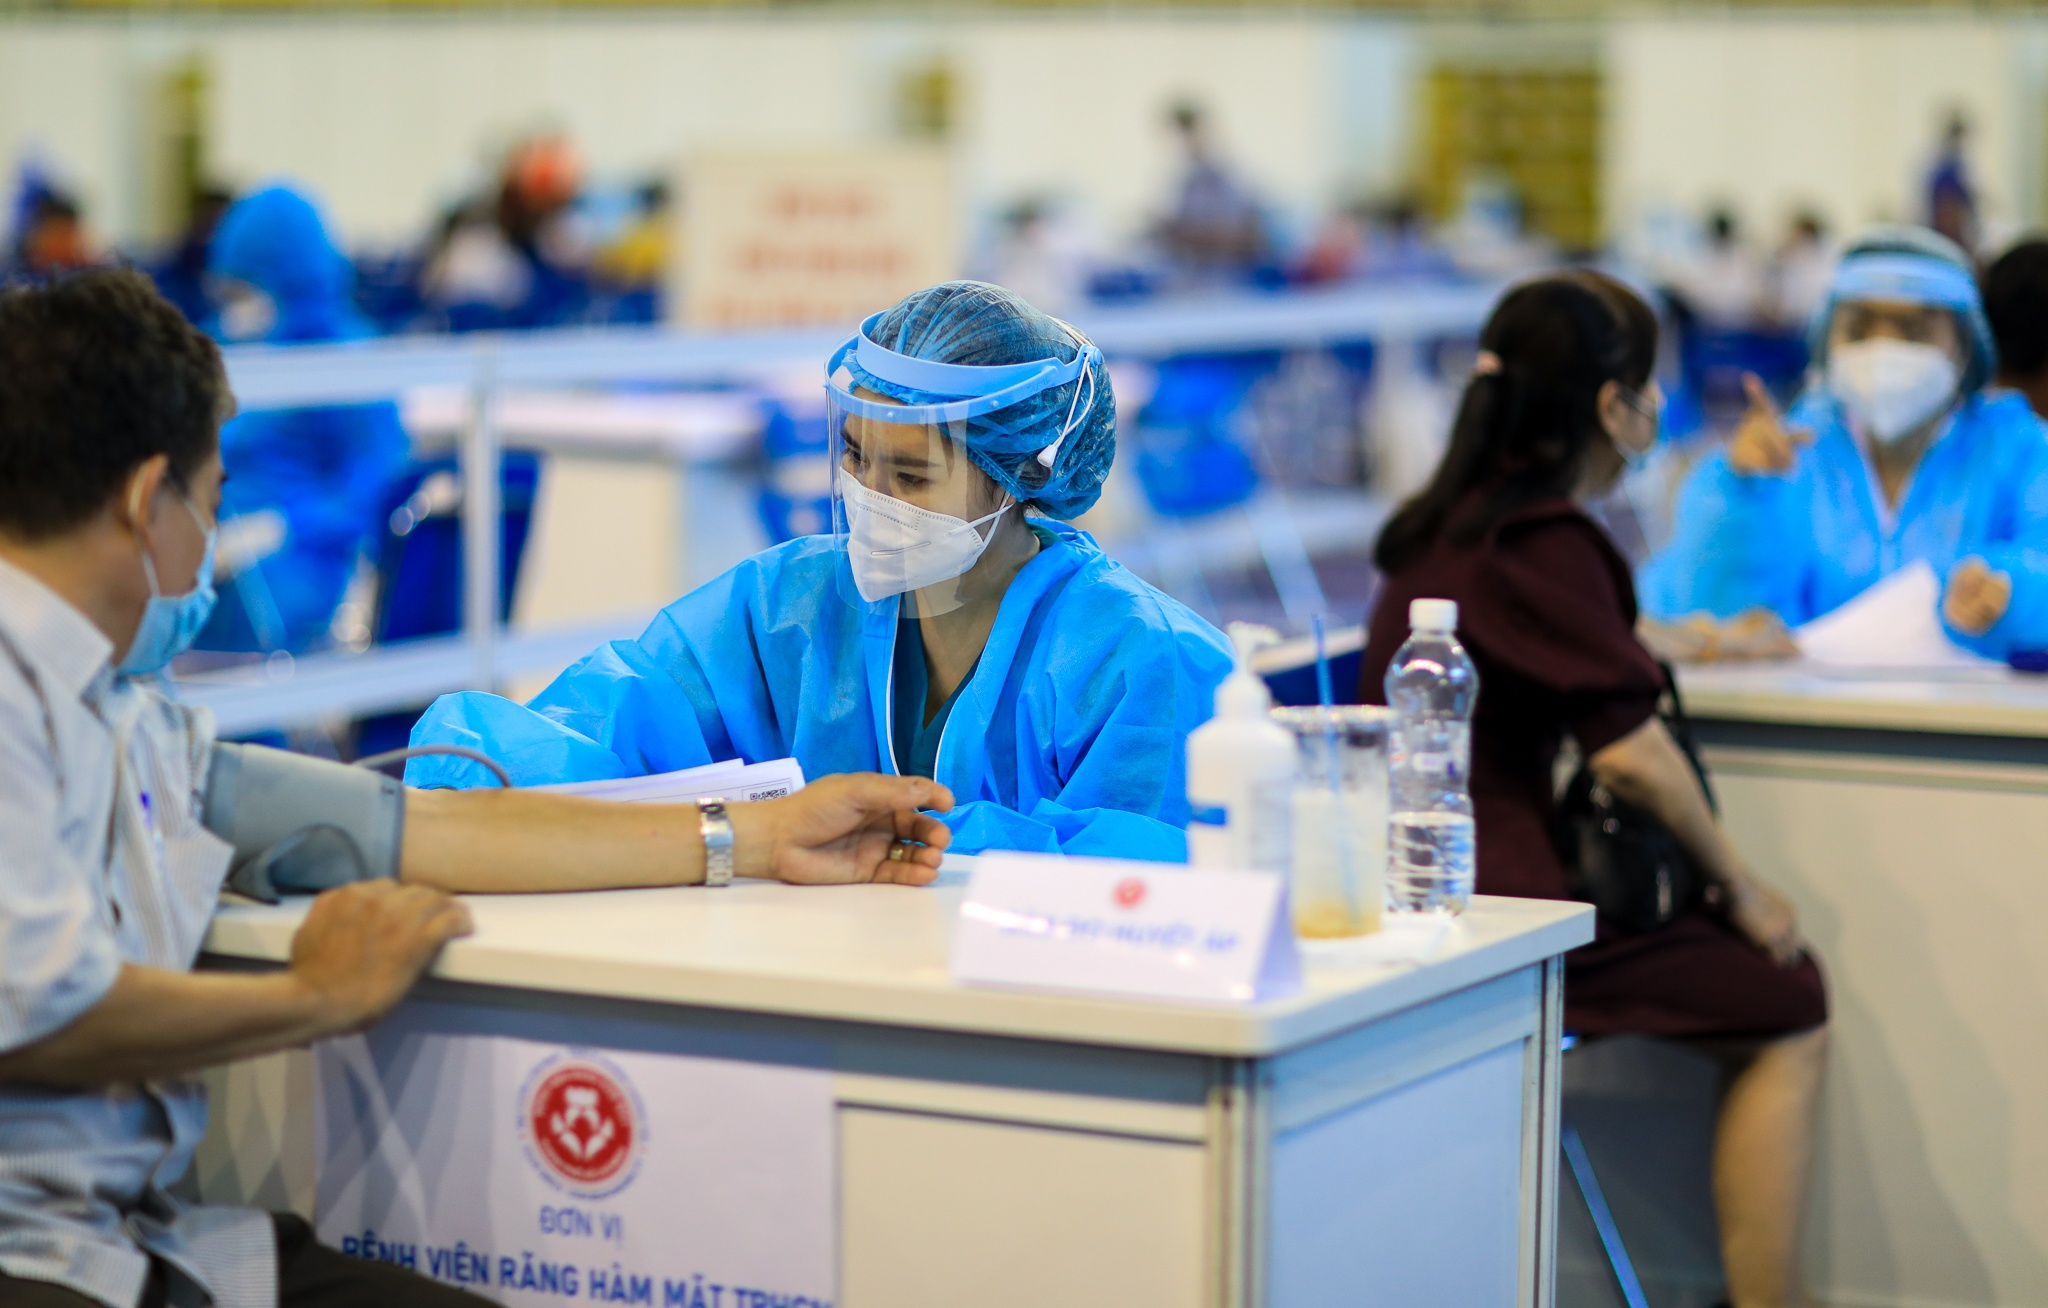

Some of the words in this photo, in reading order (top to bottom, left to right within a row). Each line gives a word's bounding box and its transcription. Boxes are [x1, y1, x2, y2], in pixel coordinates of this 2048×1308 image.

[538, 1205, 593, 1237] ĐƠN
[600, 1211, 623, 1250] VỊ
[426, 1240, 490, 1290] VIỆN
[499, 1251, 579, 1297] RĂNG
[589, 1262, 652, 1307] HÀM
